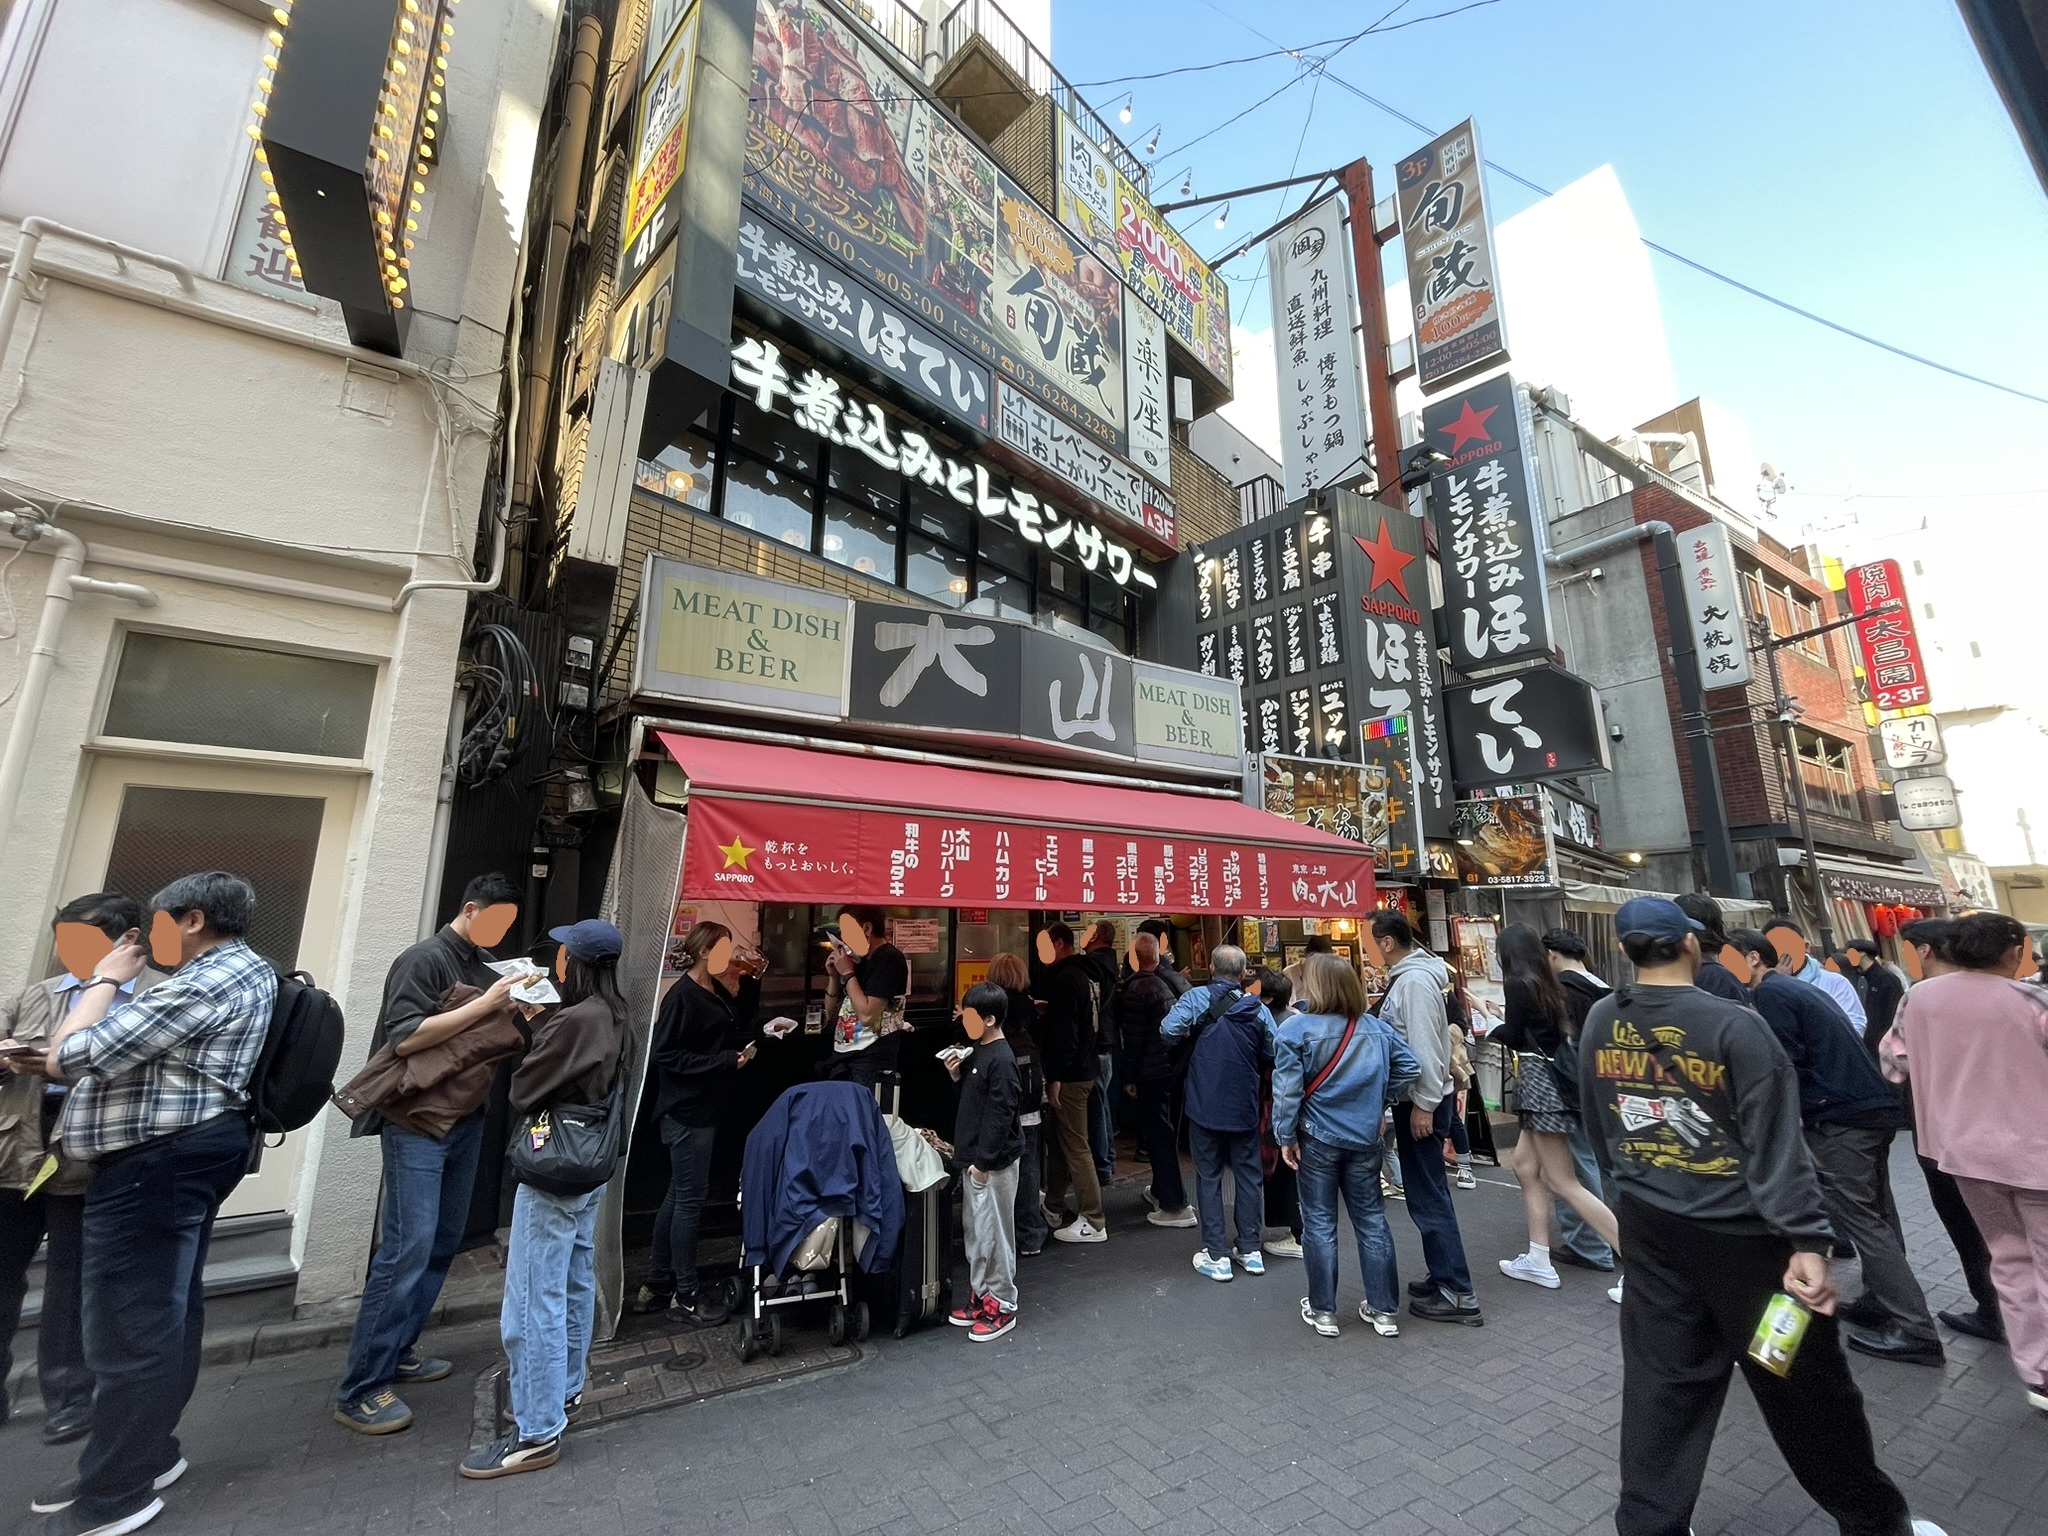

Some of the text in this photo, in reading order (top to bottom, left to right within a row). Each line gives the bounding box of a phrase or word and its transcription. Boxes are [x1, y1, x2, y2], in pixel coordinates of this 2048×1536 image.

[1070, 133, 1093, 179] 肉
[1401, 157, 1428, 183] 3F
[634, 202, 667, 268] 4F
[1016, 218, 1067, 268] 100円〜
[738, 221, 853, 317] 牛煮込み
[1131, 246, 1195, 324] 食べ放題
[1205, 270, 1224, 301] 4F
[736, 252, 854, 338] レモンサワー
[1128, 267, 1194, 348] 飲み放題
[857, 298, 986, 413] ほてい
[1310, 267, 1344, 454] 九州料理 博多もつ鍋
[1016, 363, 1117, 446] 03-6284-2283
[1131, 336, 1164, 440] 楽座
[1286, 292, 1319, 489] 直送鮮魚 しゃぶしゃぶ
[730, 336, 1158, 589] 牛煮込みとレモンサワー
[1030, 408, 1142, 497] エレベーターで
[1031, 434, 1142, 519] お上がり下さい
[1443, 439, 1503, 471] SAPPORO
[1308, 516, 1333, 579] 牛串
[1447, 474, 1481, 599] レモンサワー
[1473, 459, 1525, 593] 牛煮込み
[1221, 569, 1242, 610] 餃子
[1251, 539, 1268, 601] ニンニク炒め
[1859, 563, 1890, 603] 焼肉
[672, 586, 843, 643] MEAT DISH
[1317, 603, 1340, 666] よだれ鶏
[1360, 595, 1422, 627] SAPPORO
[713, 645, 800, 684] BEER
[745, 626, 772, 654] &
[1255, 626, 1274, 680] ハムカツ
[1286, 614, 1306, 674] タンタン麺
[1699, 604, 1740, 675] 大統領
[873, 612, 1118, 744] 大山
[1138, 681, 1233, 717] MEAT DISH
[1164, 725, 1214, 750] BEER
[1181, 708, 1195, 729] &
[1290, 701, 1312, 758] シューマイ
[1321, 691, 1347, 748] ユッケ
[1413, 630, 1443, 810] 牛煮込み・レモンサワー
[1907, 720, 1934, 763] カドクラ
[763, 857, 856, 876] もっとおいしく。
[764, 840, 809, 856] 乾杯を
[904, 822, 920, 869] 和牛の
[940, 829, 955, 898] ハンバーグ
[955, 827, 971, 862] 大山
[995, 831, 1010, 900] ハムカツ
[1046, 835, 1059, 877] エビス
[1163, 844, 1175, 884] 豚もつ
[1291, 863, 1327, 876] 東京 上野
[714, 872, 755, 884] SAPPORO
[889, 849, 906, 897] タタキ
[1035, 858, 1048, 902] ビール
[1082, 838, 1095, 904] 黒ラベル
[1116, 856, 1128, 904] ステーキ
[1126, 842, 1139, 905] 東京ビーフ
[1154, 865, 1166, 906] 煮込み
[1188, 856, 1200, 907] ステーキ
[1222, 858, 1233, 908] コロッケ
[1229, 850, 1242, 901] やみつき
[1291, 877, 1358, 909] 肉の大山
[1487, 875, 1546, 885] 03-5817-3929
[1596, 1049, 1650, 1080] NEW
